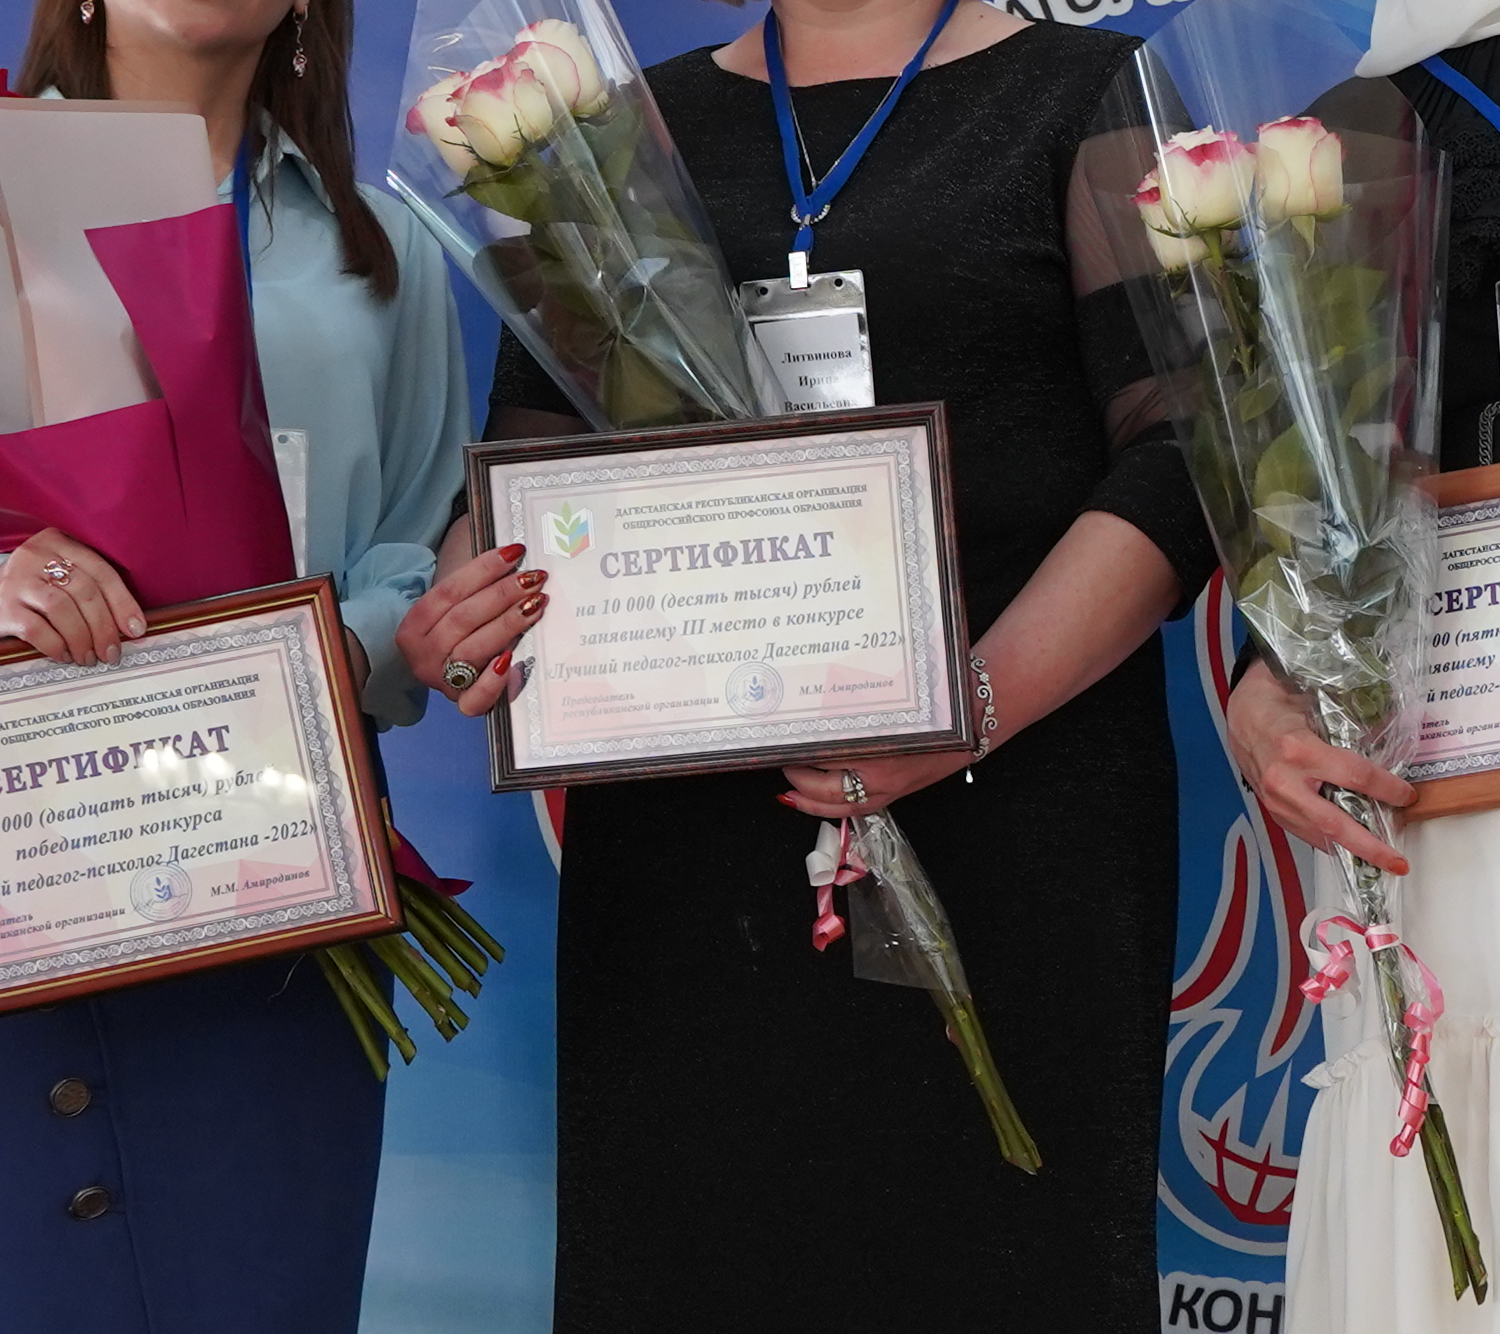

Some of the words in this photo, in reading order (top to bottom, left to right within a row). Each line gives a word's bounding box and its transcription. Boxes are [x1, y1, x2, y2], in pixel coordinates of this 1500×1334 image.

[781, 349, 852, 364] Литвинова
[615, 501, 693, 518] ДАГЕСТАНСКАЯ
[695, 491, 794, 508] РЕСПУБЛИКАНСКАЯ
[796, 484, 867, 499] ОРГАНИЗАЦИЯ
[623, 511, 726, 530] ОБЩЕРОССИЙСКОГО
[728, 506, 791, 520] ПРОФСОЮЗА
[793, 499, 862, 513] ОБРАЗОВАНИЯ
[600, 531, 834, 579] СЕРТИФИКАТ
[576, 604, 596, 617] на
[602, 598, 621, 616] 10
[626, 594, 655, 613] 000
[661, 590, 728, 613] (десять
[734, 581, 798, 602] тысяч)
[802, 575, 861, 600] рублей
[579, 625, 676, 646] занявшему
[680, 618, 706, 637] III
[709, 617, 766, 634] место
[772, 619, 781, 628] в
[786, 607, 864, 627] конкурсе
[622, 648, 759, 673] педагог-психолог
[762, 639, 849, 662] Дагестана
[854, 630, 906, 649] -2022»
[1430, 654, 1496, 675] явшему
[77, 688, 182, 716] РЕСПУБЛИКАНСКАЯ
[185, 673, 260, 695] ОРГАНИЗАЦИЯ
[654, 697, 720, 713] организации
[799, 685, 826, 696] М.М.
[829, 678, 894, 693] Амиродинов
[1, 717, 111, 745] ОБЩЕРОССИЙСКОГО
[114, 704, 180, 724] ПРОФСОЮЗА
[183, 689, 256, 711] ОБРАЗОВАНИЯ
[1, 811, 33, 833] 000
[39, 796, 135, 828] (двадцать
[141, 780, 209, 806] тысяч)
[214, 764, 274, 795] рубле
[16, 826, 133, 861] победителю
[139, 809, 223, 836] конкурса
[16, 853, 163, 893] педагог-психолог
[167, 833, 259, 866] Дагестана
[264, 819, 318, 842] -2022»
[210, 884, 239, 897] М.М.
[242, 869, 311, 890] Амиродинов
[55, 907, 126, 930] организации
